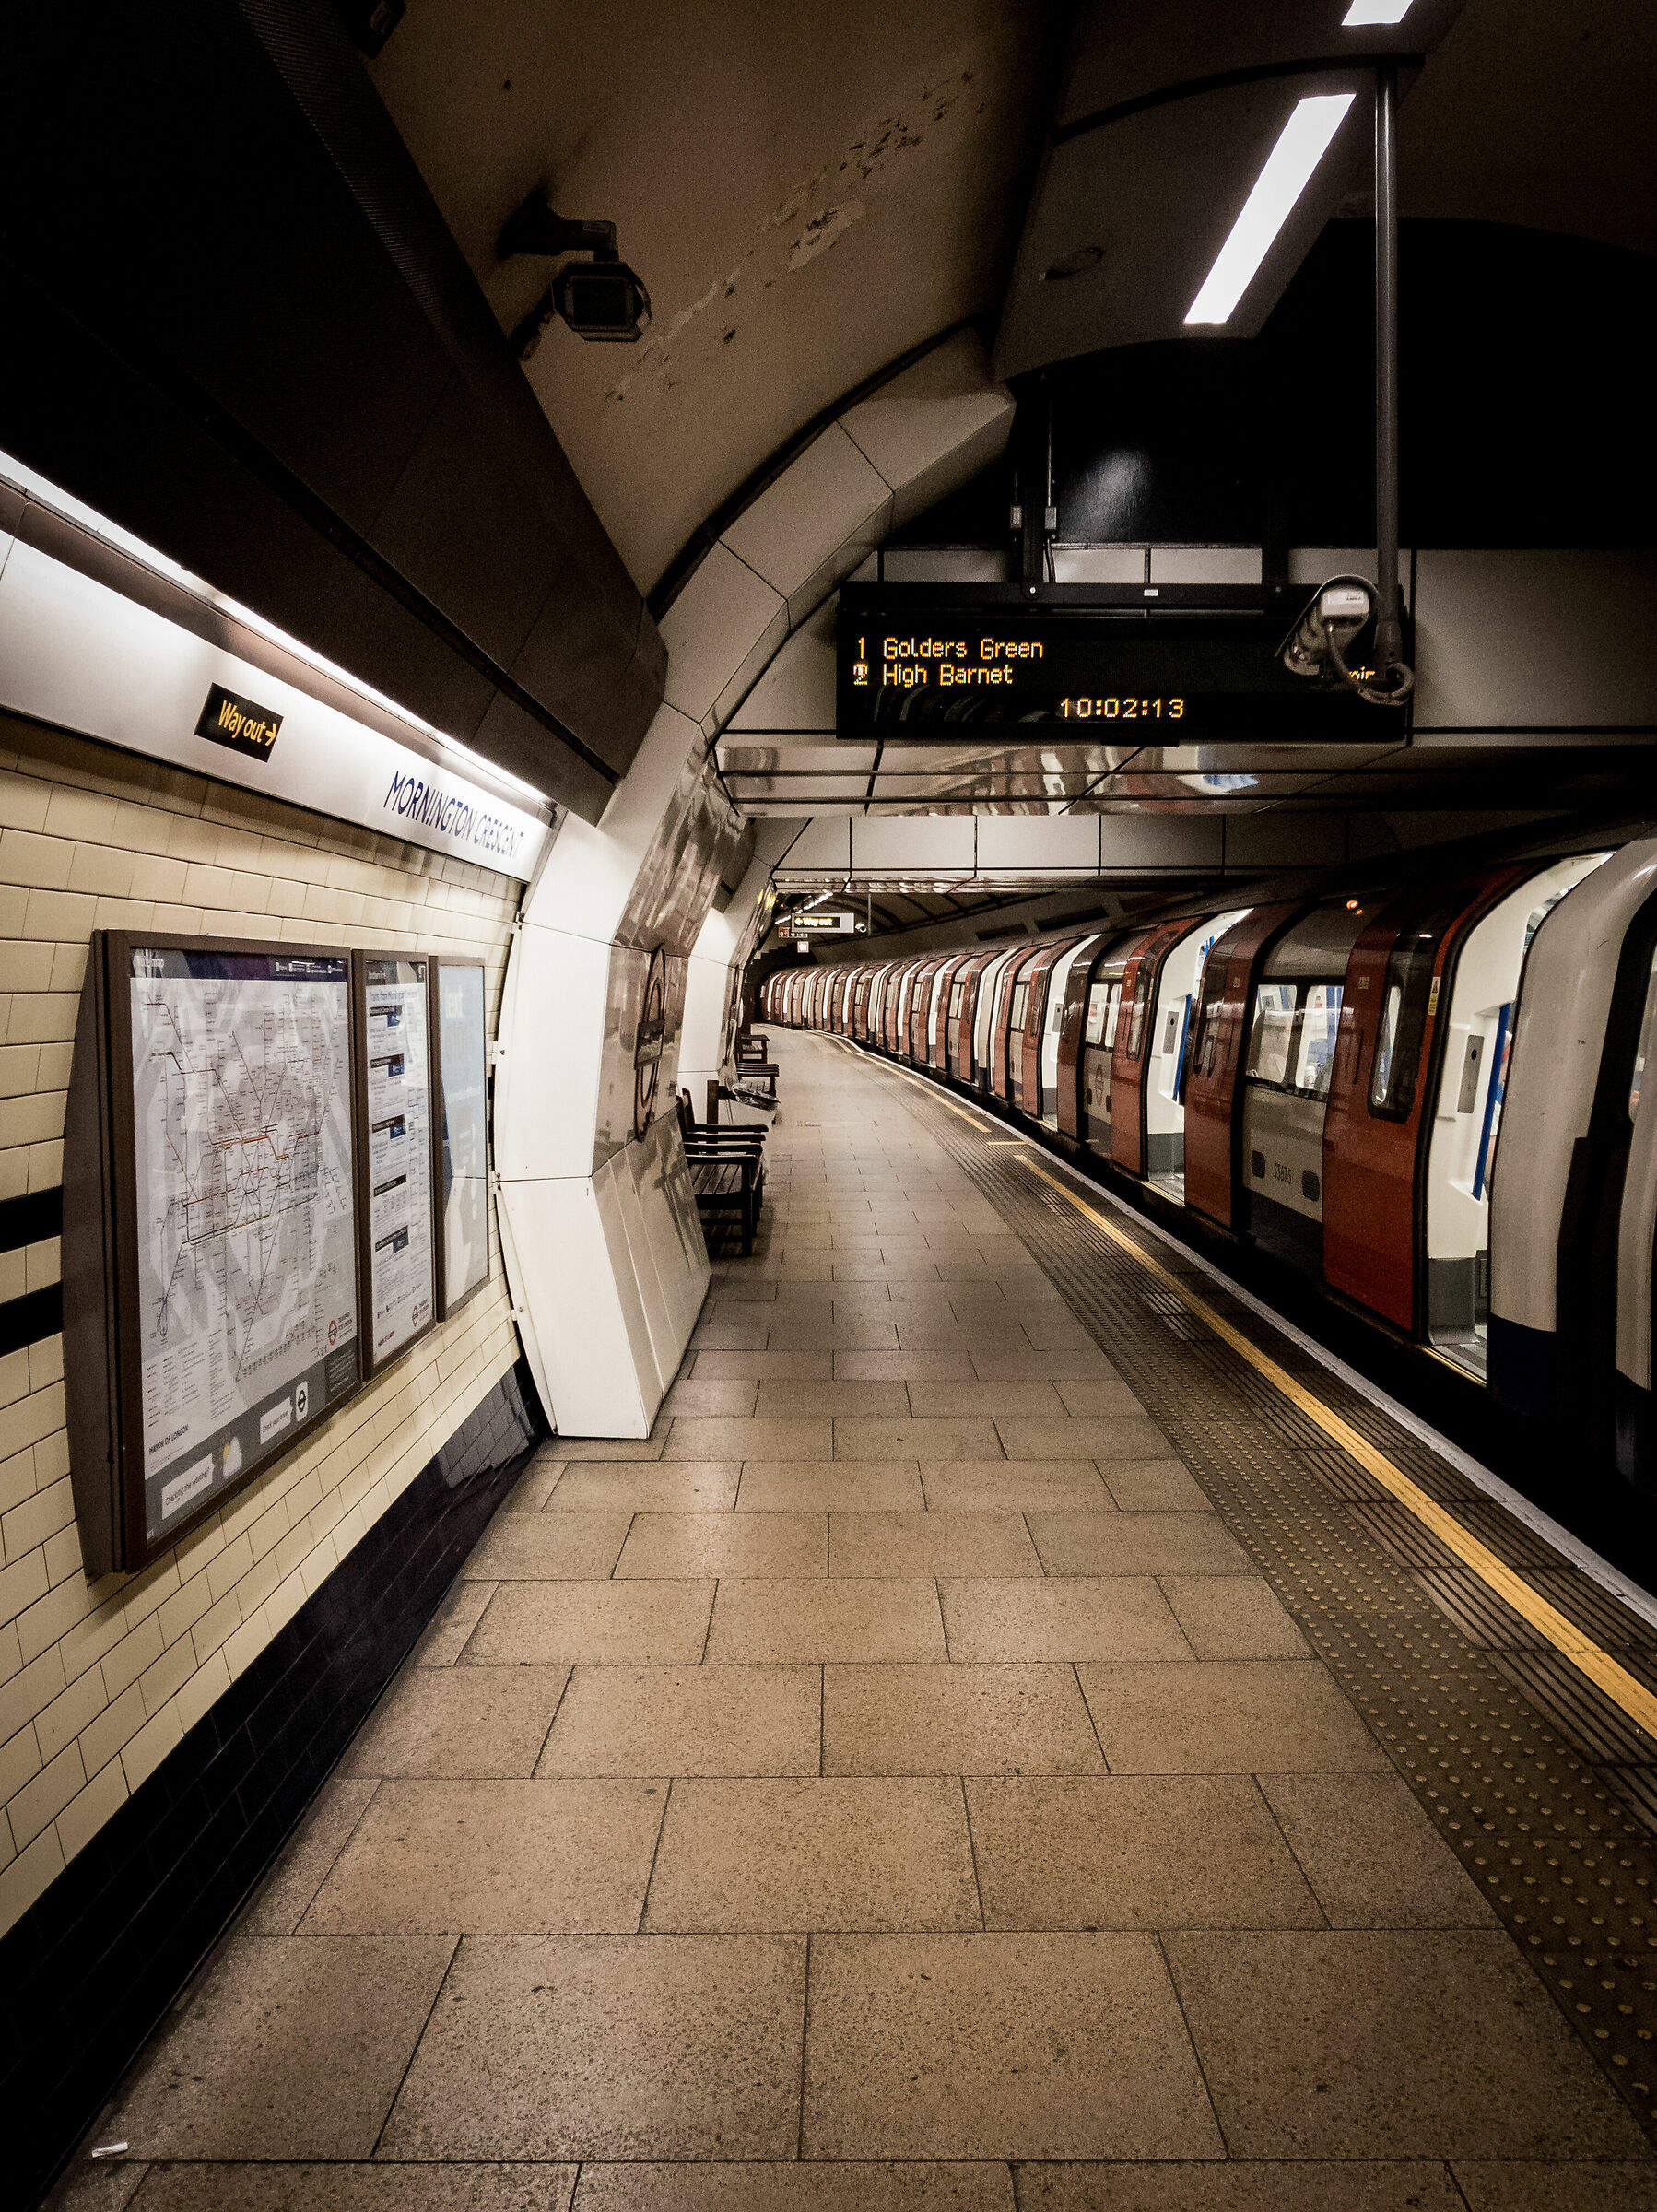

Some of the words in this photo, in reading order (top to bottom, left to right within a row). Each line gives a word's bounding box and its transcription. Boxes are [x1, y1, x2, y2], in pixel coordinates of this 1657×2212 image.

[858, 637, 864, 660] 1
[883, 637, 968, 660] Golders
[980, 638, 1043, 661] Green
[883, 663, 928, 688] High
[939, 663, 1013, 687] Barnet
[1060, 697, 1184, 719] 10:02:13
[218, 700, 246, 738] Way
[243, 719, 266, 743] out
[383, 771, 477, 841] MORNINGTON
[803, 916, 818, 926] Way
[818, 917, 833, 925] out
